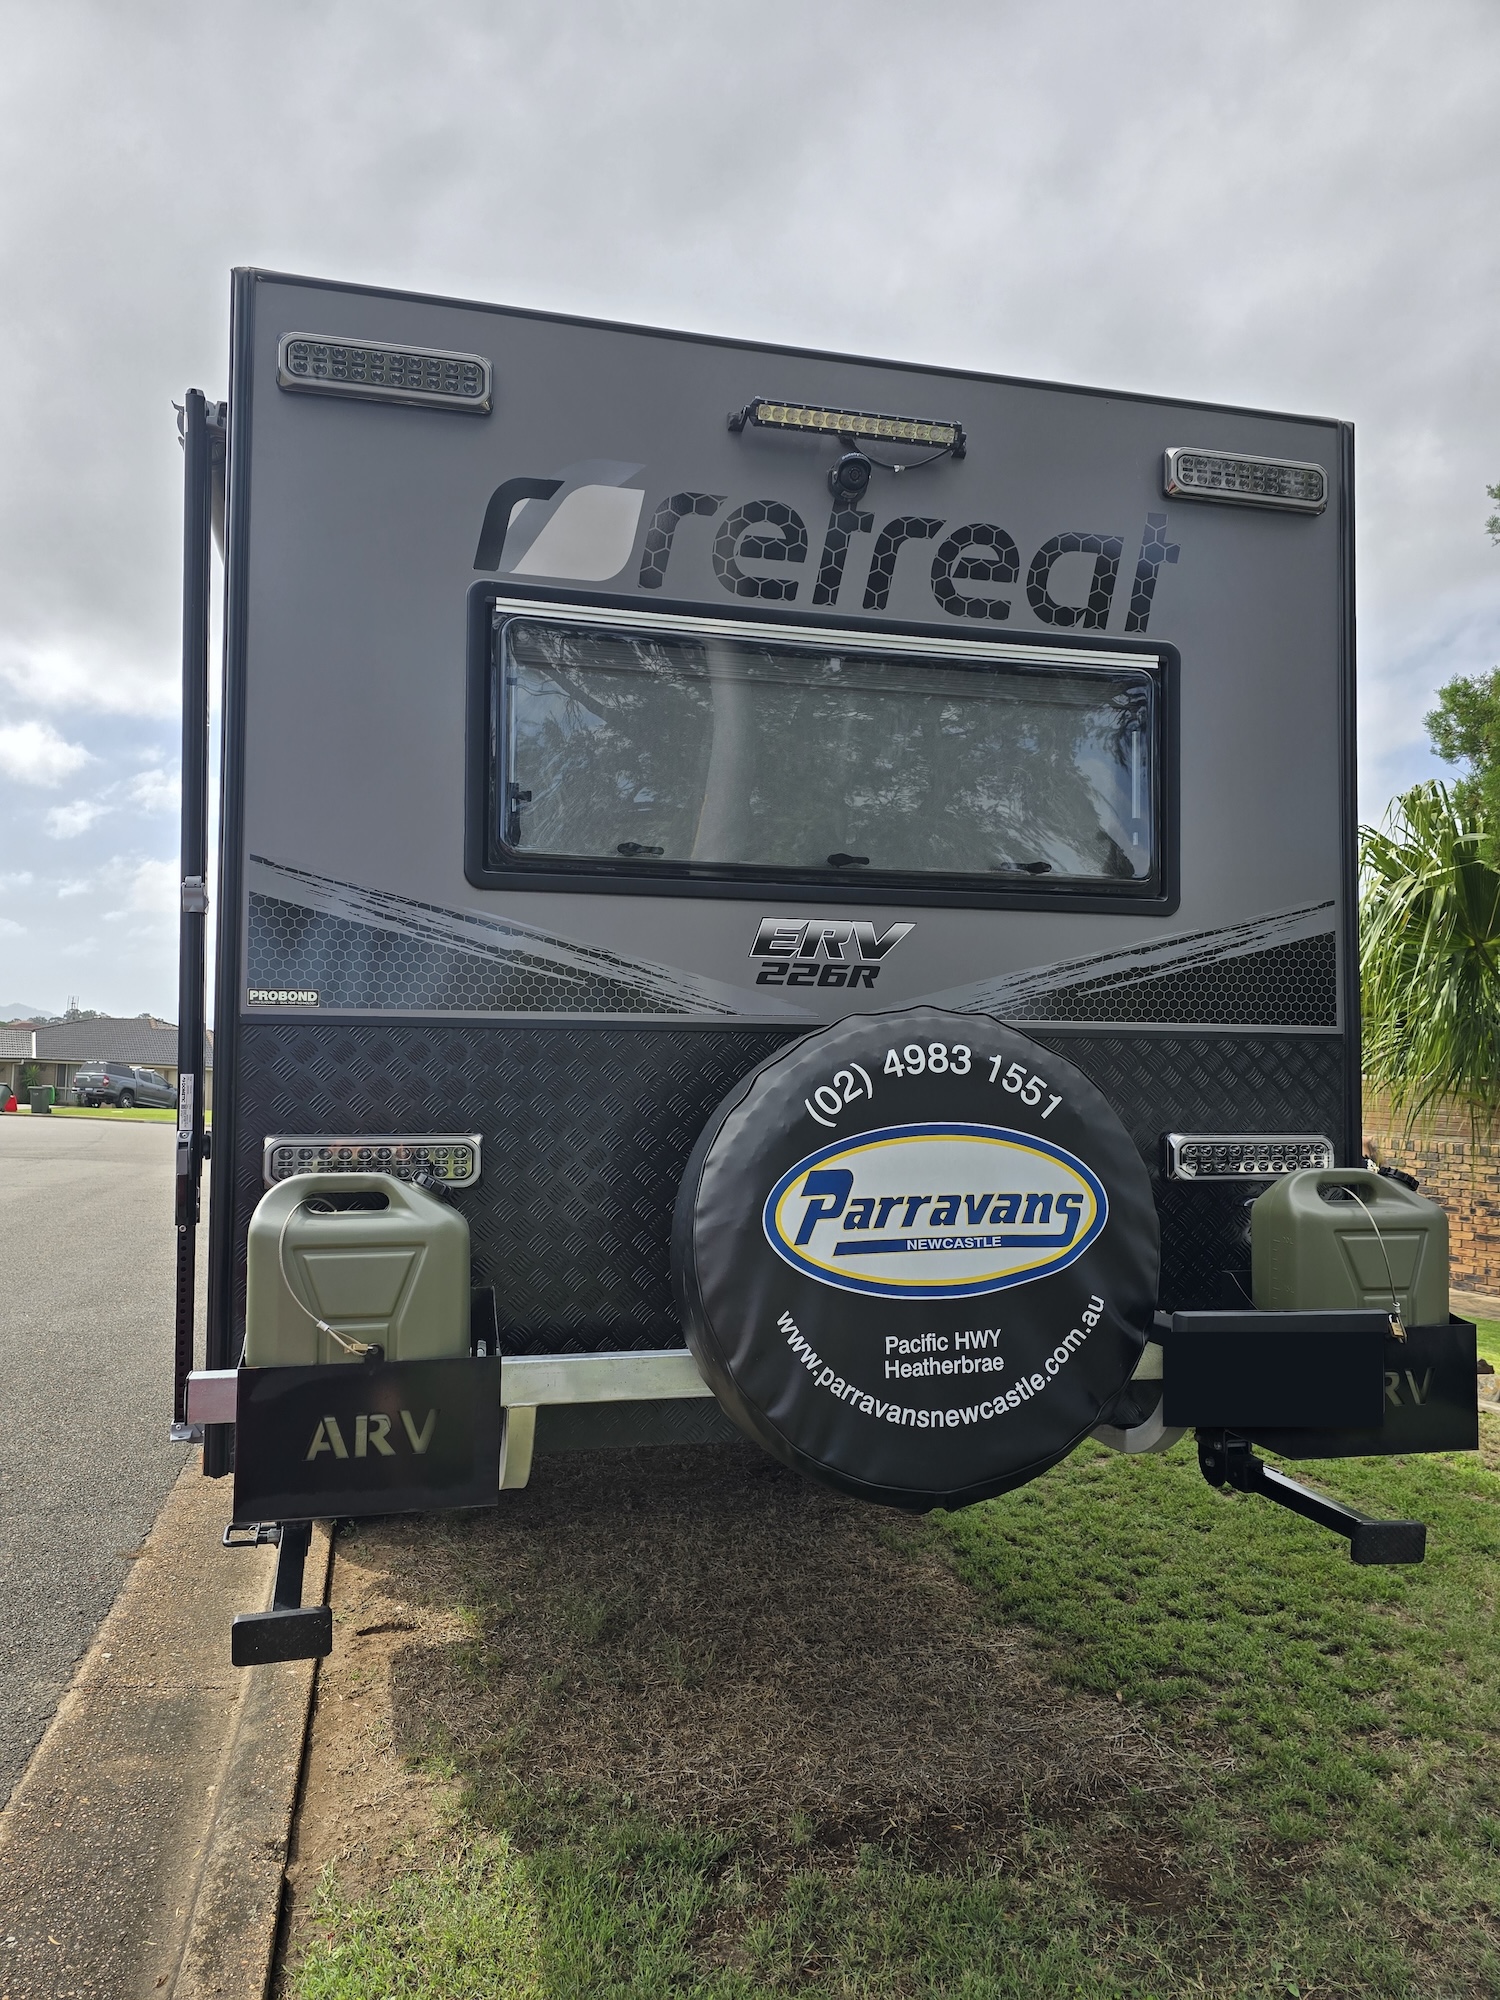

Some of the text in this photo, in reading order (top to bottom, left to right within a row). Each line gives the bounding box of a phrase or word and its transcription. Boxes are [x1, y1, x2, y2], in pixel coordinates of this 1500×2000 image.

[748, 916, 917, 962] ERV
[755, 961, 881, 989] 226R
[249, 990, 318, 1001] PROBOND
[804, 1042, 1063, 1128] (02) 4983 1551
[794, 1168, 1084, 1257] Parravans
[906, 1236, 1002, 1251] NEWCASTLE
[885, 1328, 1001, 1355] Pacific HWY
[776, 1294, 1105, 1428] www.parravansnewcastle.com.au
[884, 1355, 1005, 1379] Heatherbrae
[302, 1408, 441, 1462] ARV
